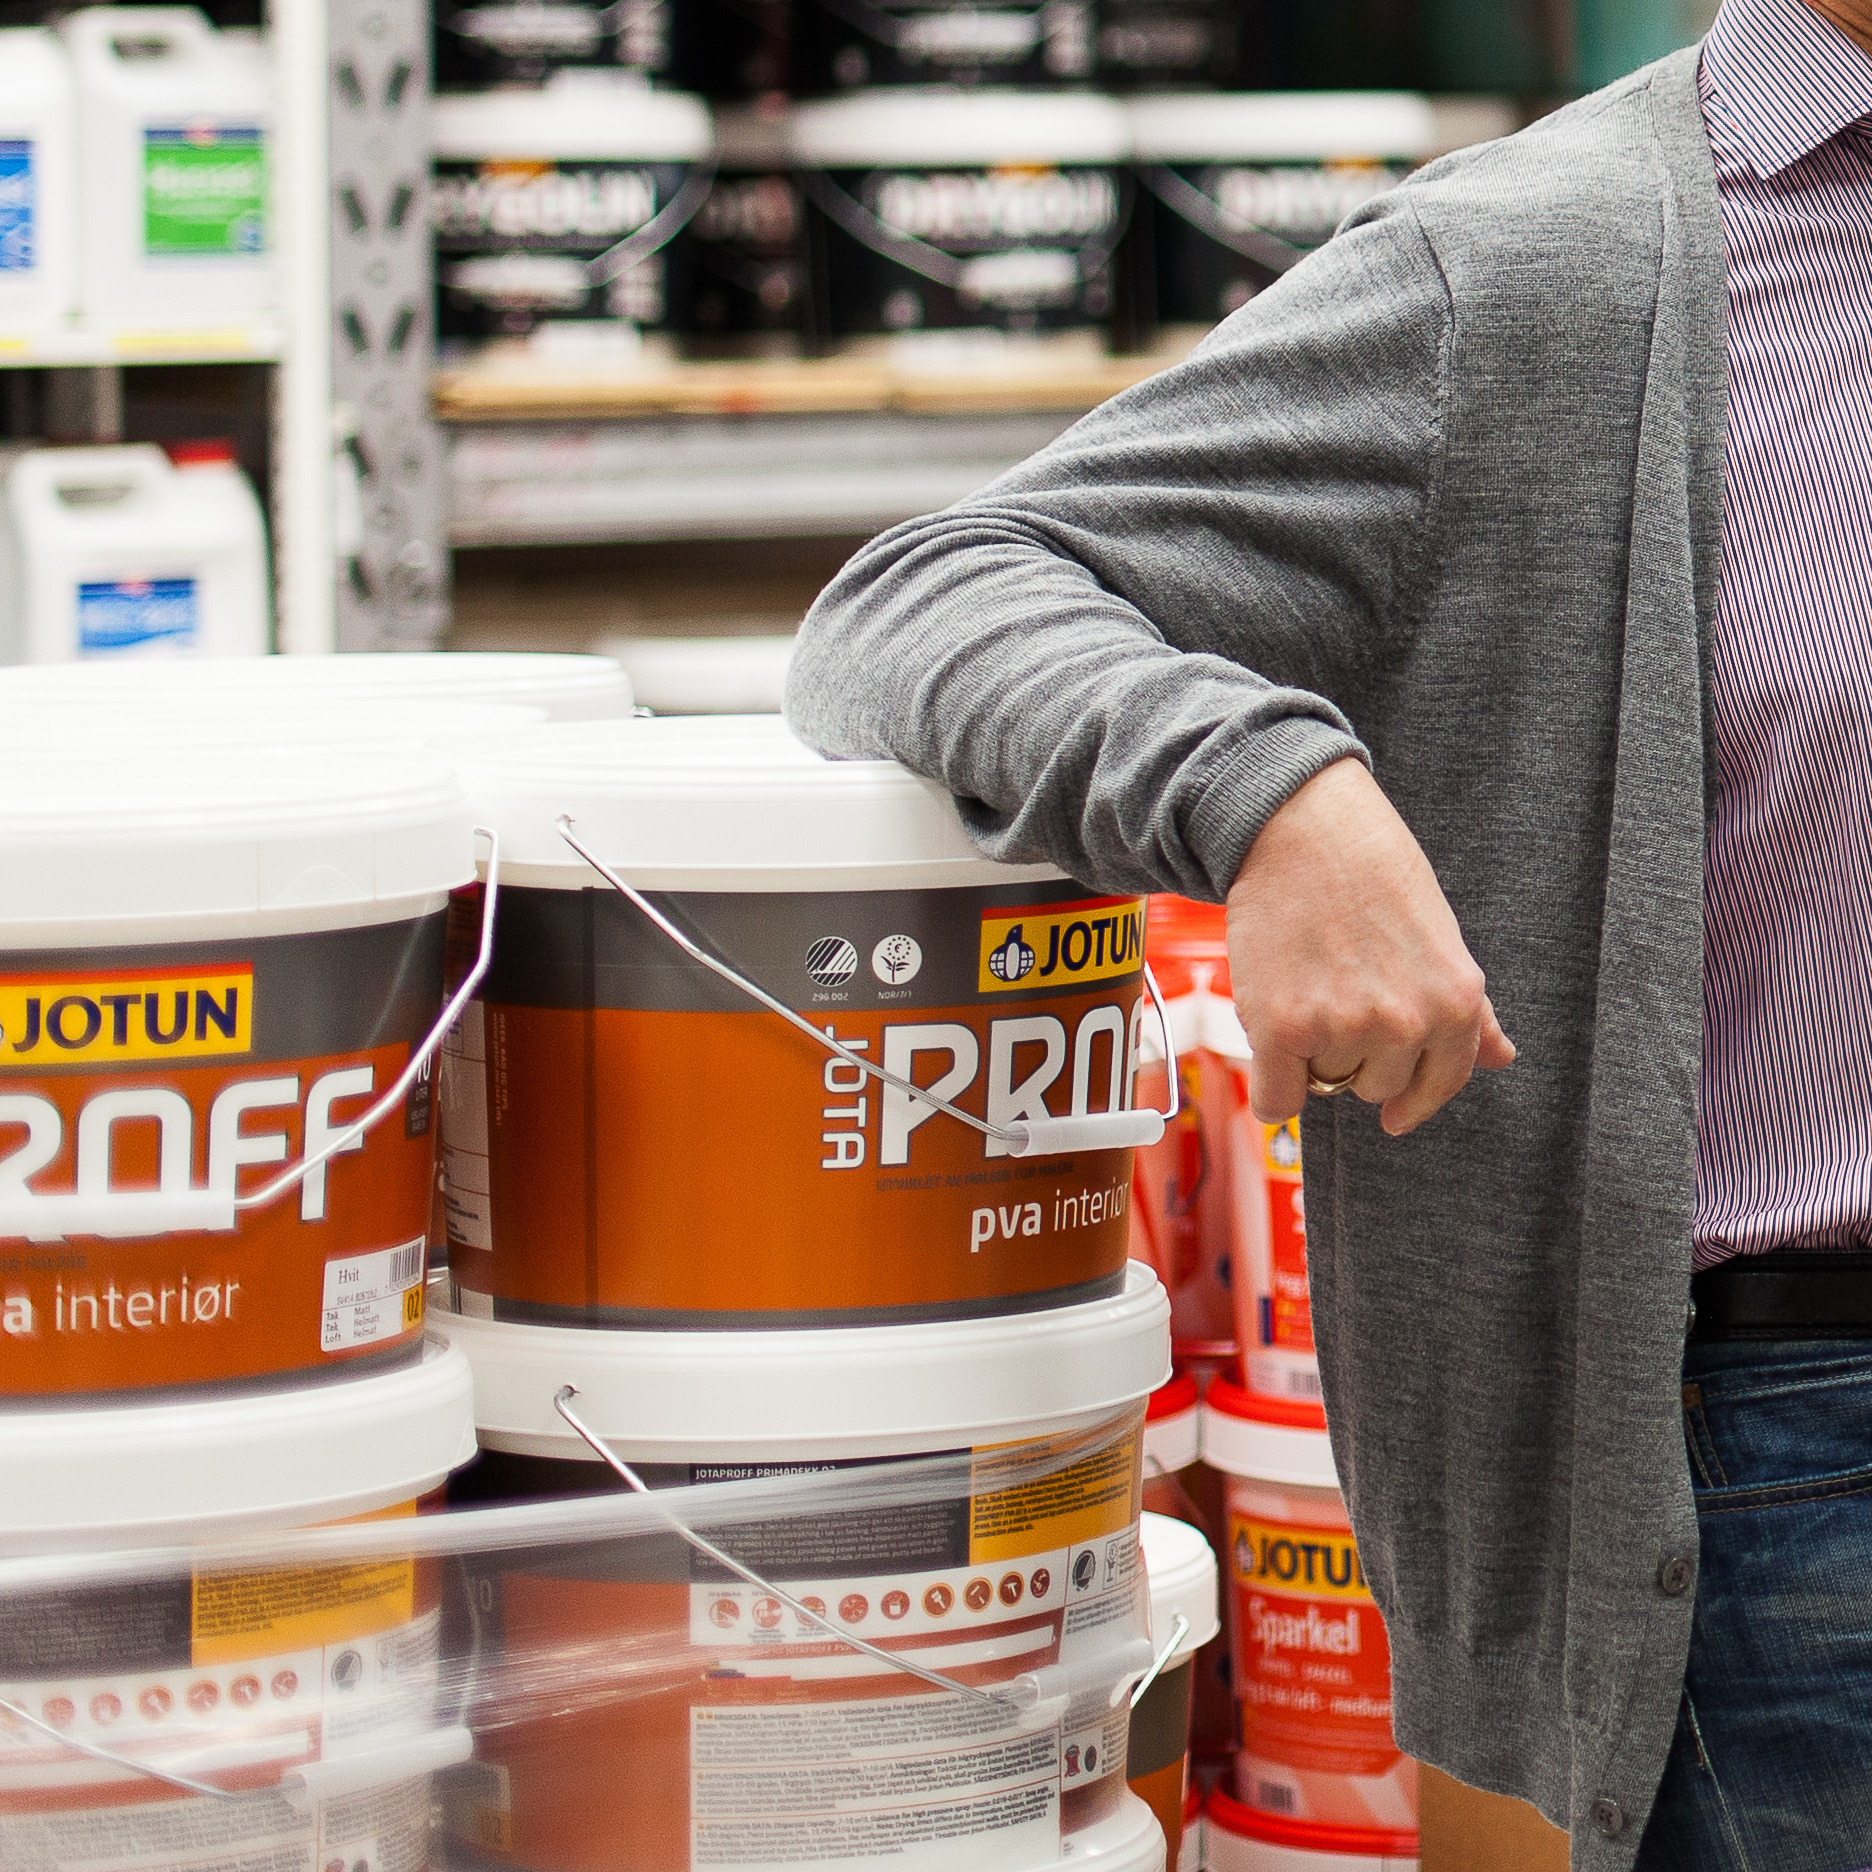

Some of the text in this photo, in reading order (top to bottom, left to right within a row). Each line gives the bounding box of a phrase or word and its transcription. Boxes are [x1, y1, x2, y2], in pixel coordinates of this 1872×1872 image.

[1039, 910, 1143, 977] JOTUN
[12, 987, 238, 1053] JOTUN
[821, 1025, 870, 1169] JOTA
[971, 1176, 1129, 1253] pva interiør
[54, 1275, 240, 1331] interiør
[338, 1269, 360, 1284] Hvit
[407, 1290, 420, 1322] 02
[695, 1468, 754, 1480] JOTAPROFF
[1249, 1594, 1361, 1656] Sparkel
